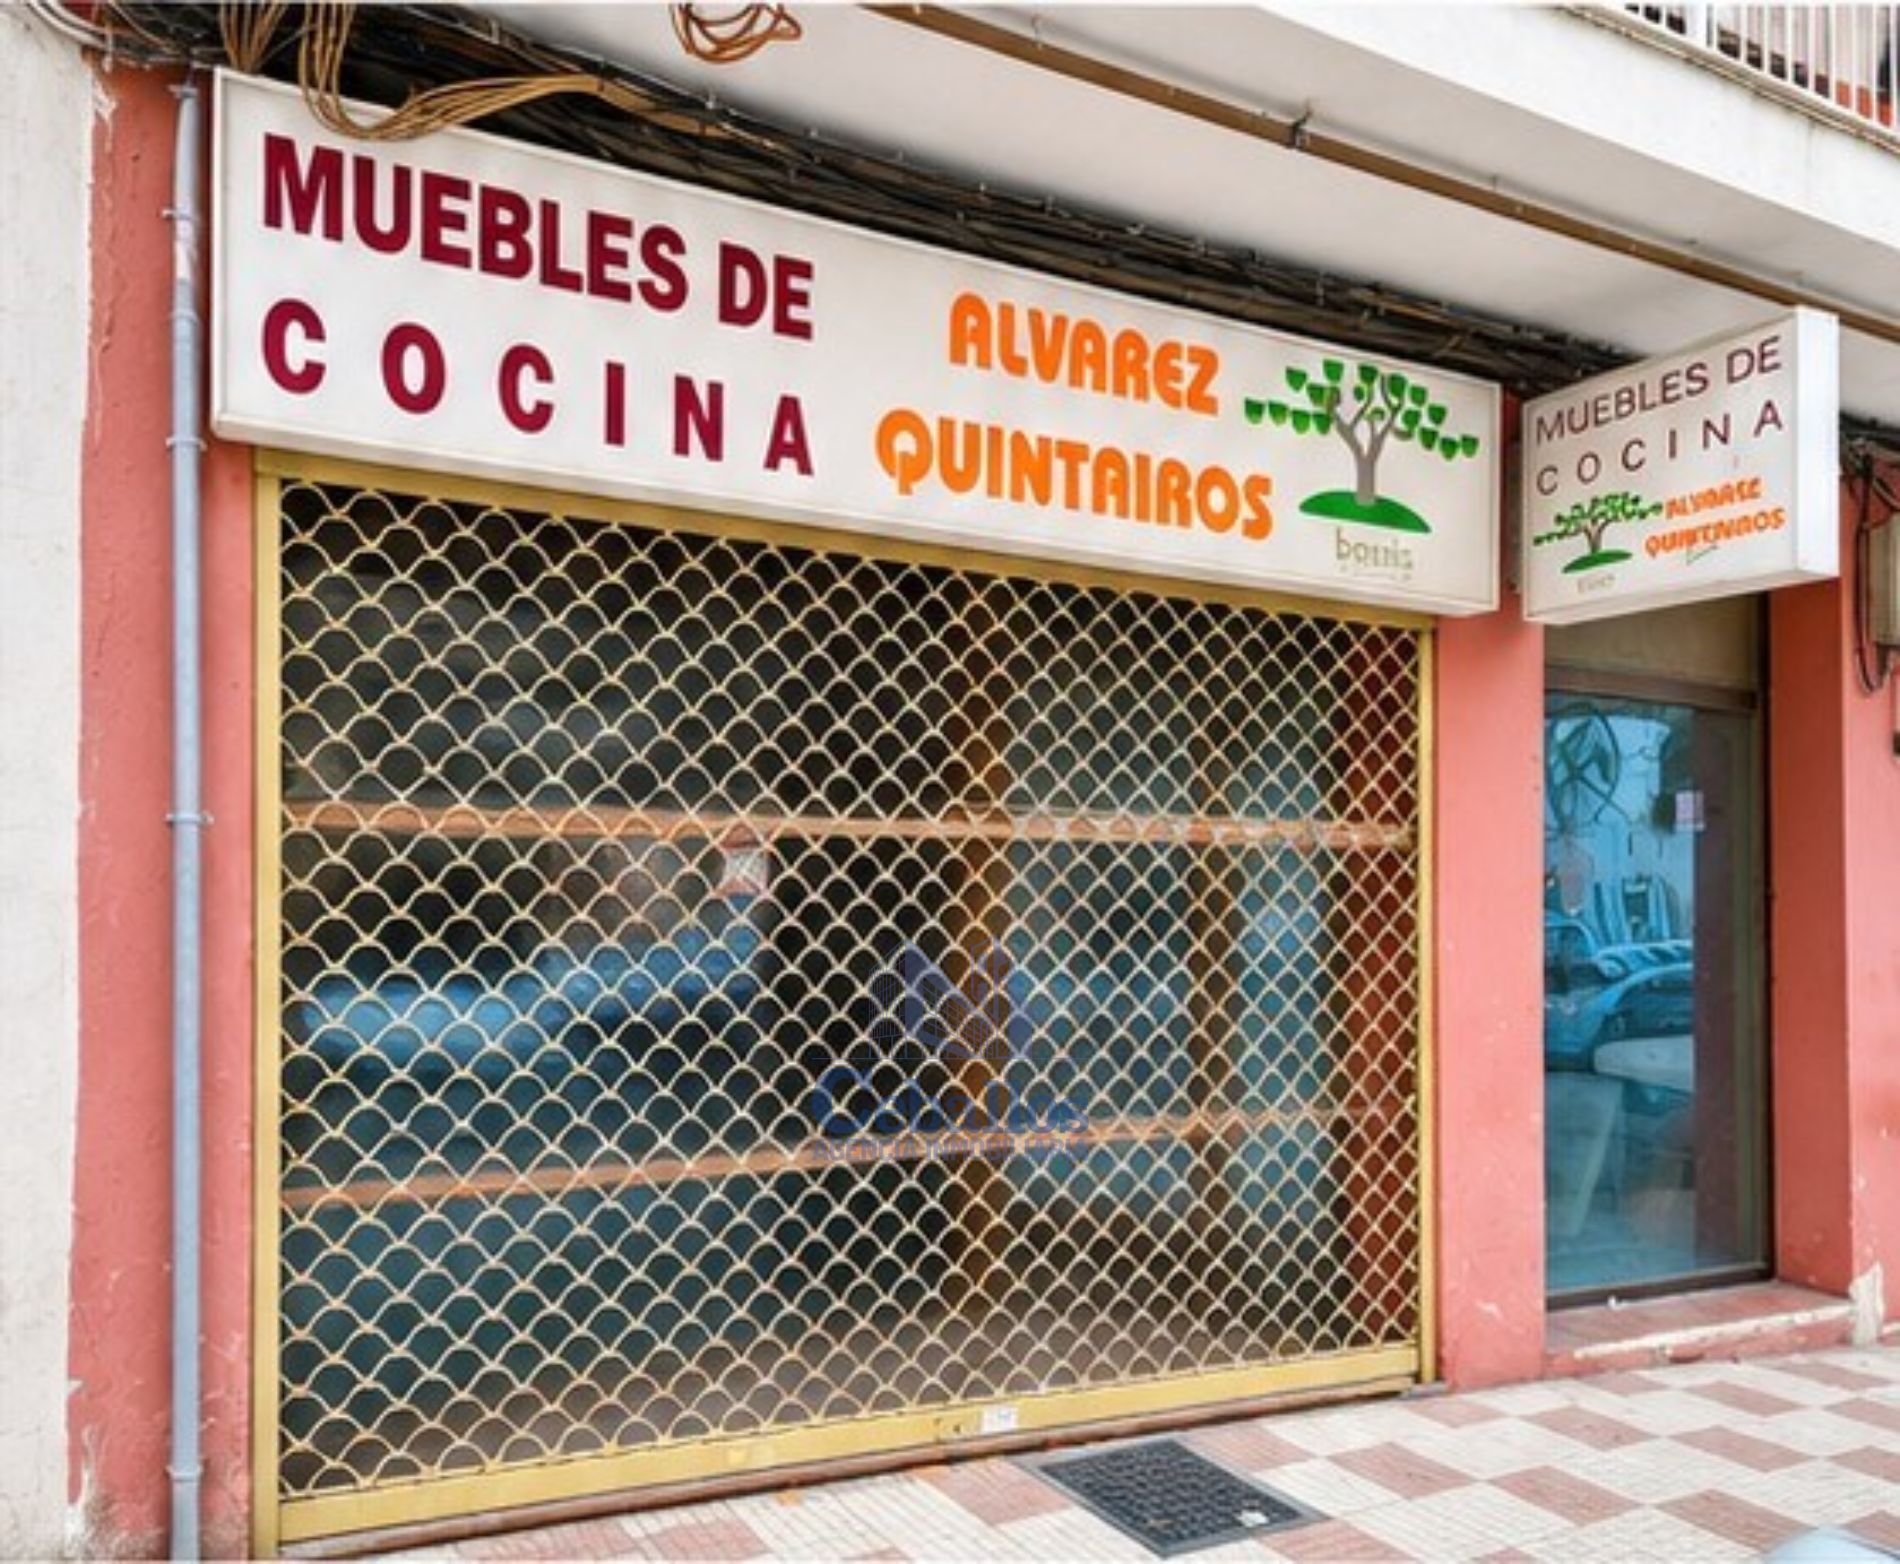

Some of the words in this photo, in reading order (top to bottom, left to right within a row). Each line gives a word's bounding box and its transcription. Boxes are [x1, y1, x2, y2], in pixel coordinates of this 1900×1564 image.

[264, 133, 688, 312] MUEBLES
[718, 241, 814, 340] DE
[262, 298, 814, 475] COCINA
[950, 293, 1220, 415] ALVAREZ
[1536, 363, 1709, 446] MUEBLES
[1726, 336, 1782, 384] DE
[876, 409, 1273, 540] QUINTAIROS
[1536, 400, 1783, 496] COCINA
